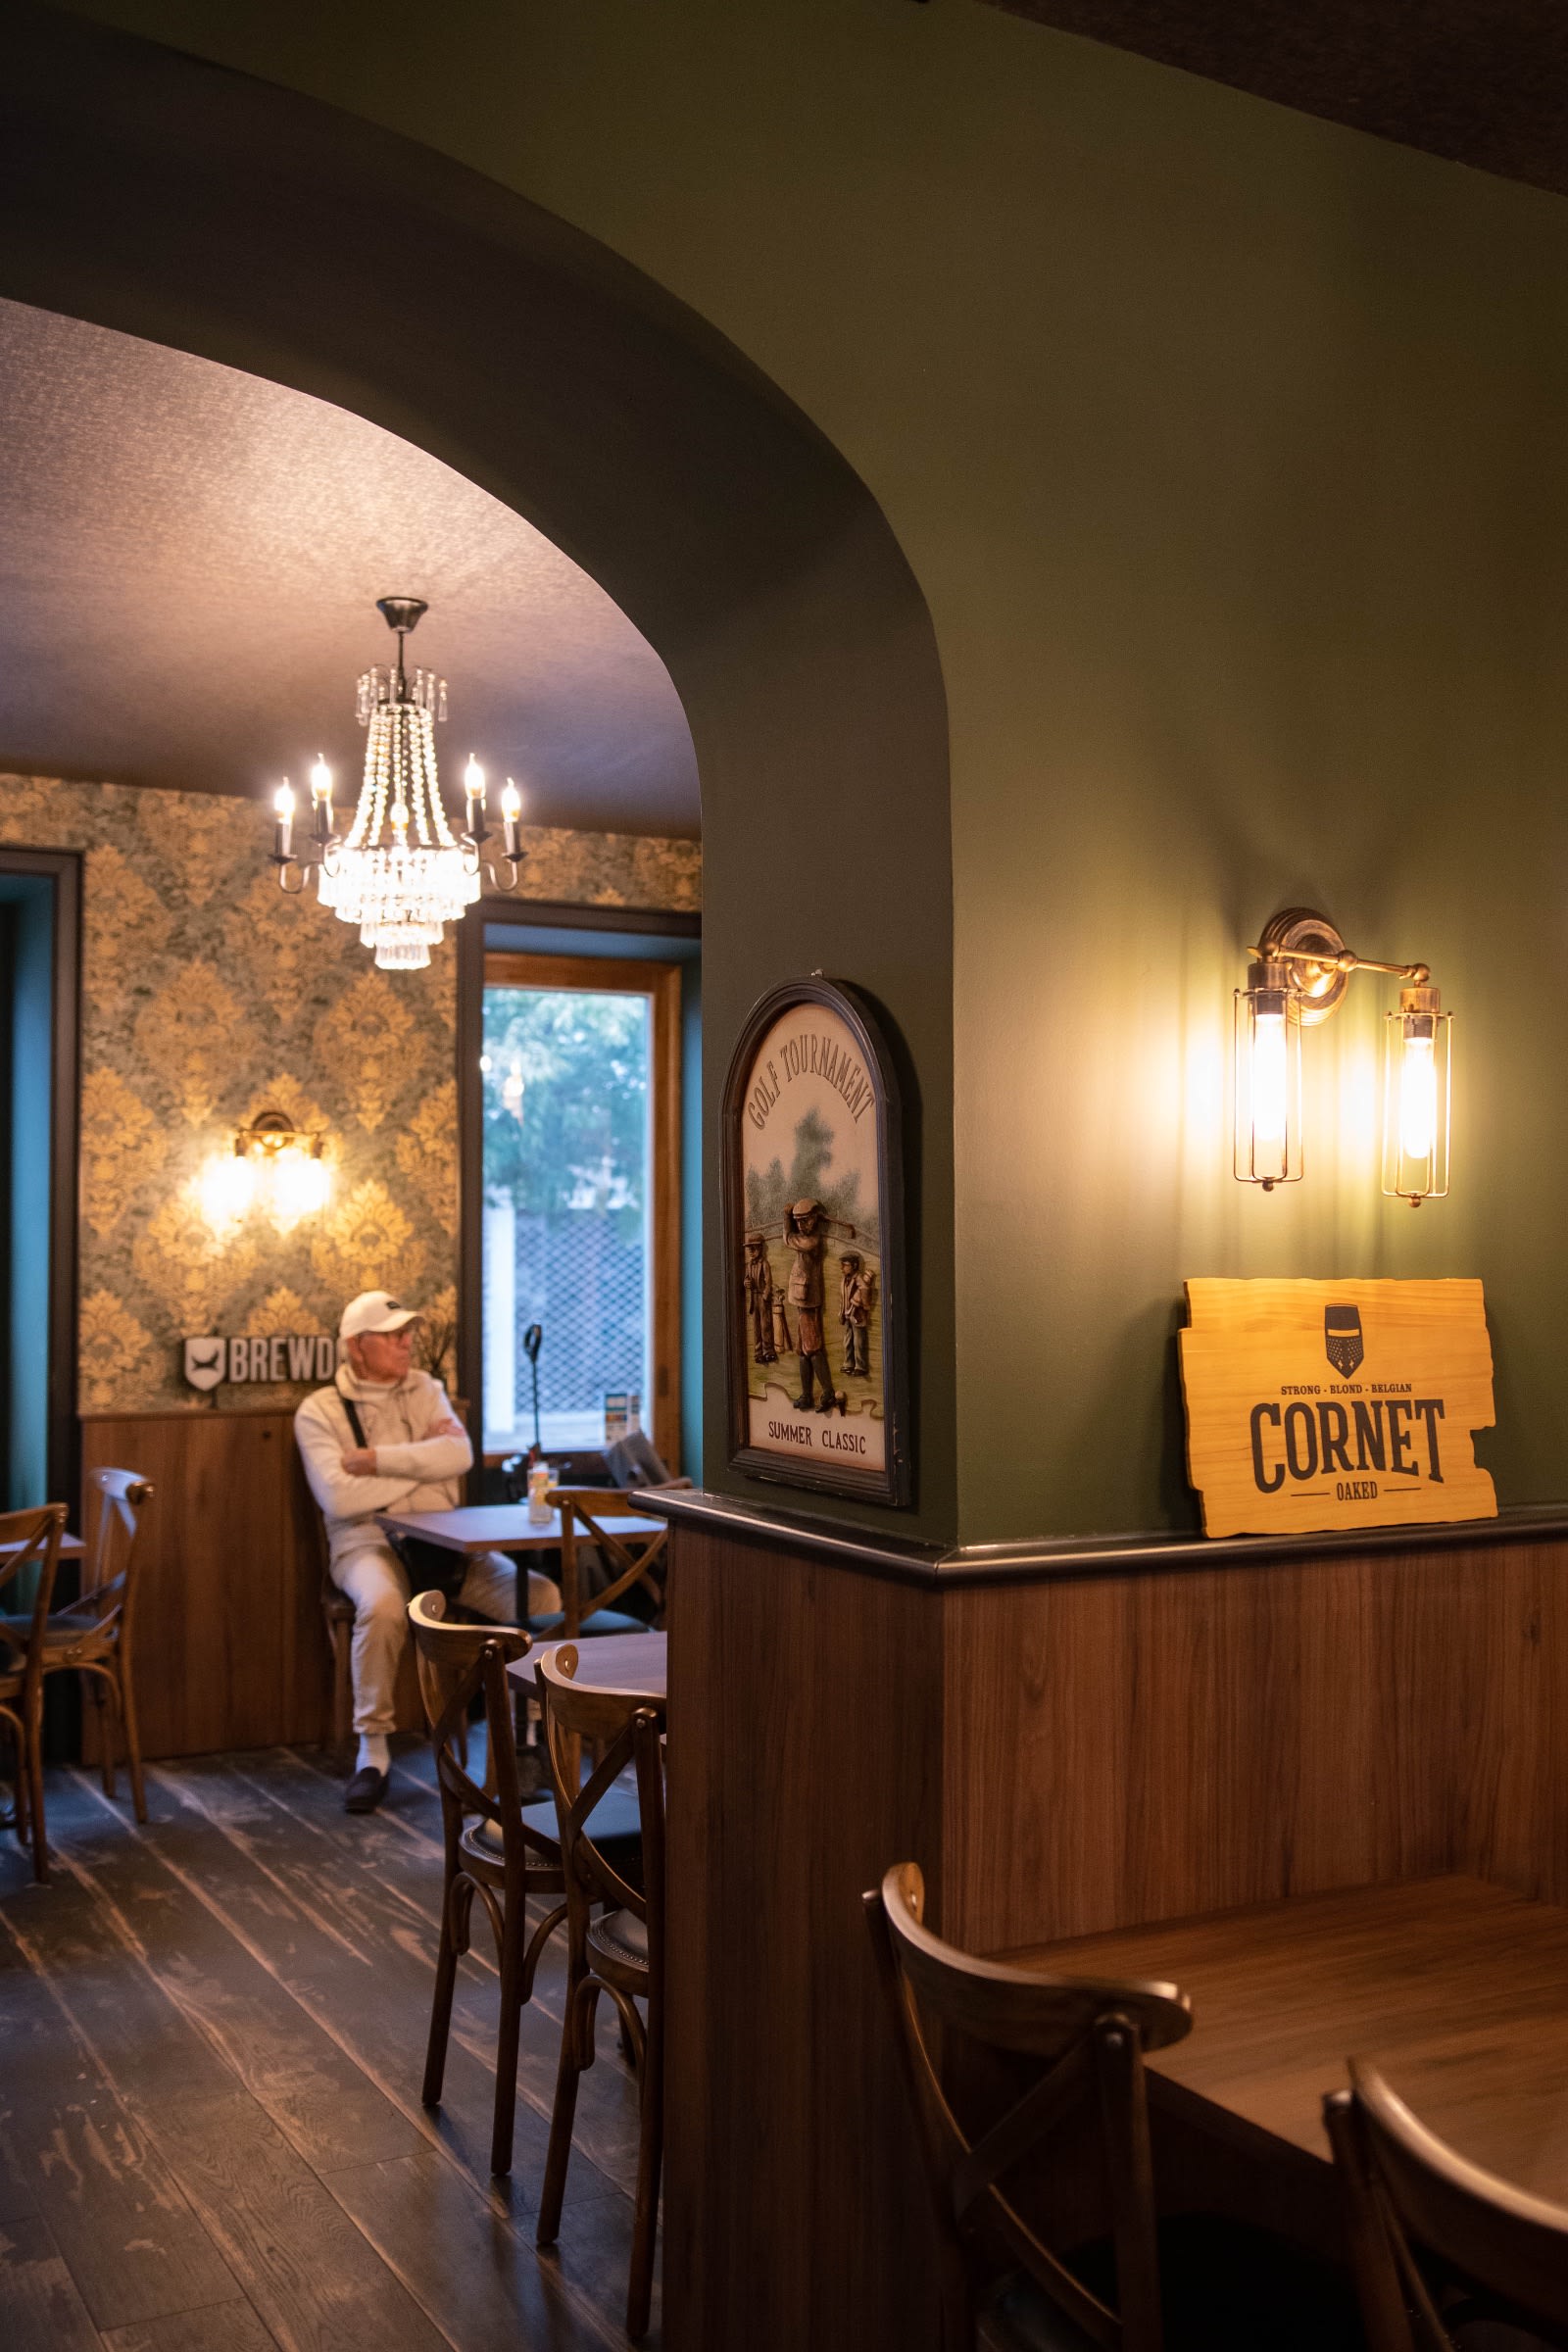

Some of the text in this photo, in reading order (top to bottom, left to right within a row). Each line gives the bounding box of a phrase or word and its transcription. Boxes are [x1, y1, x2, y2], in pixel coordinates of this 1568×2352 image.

[748, 1033, 875, 1130] GOLF TOURNAMENT
[1281, 1383, 1412, 1396] STRONG BLOND BELGIAN
[768, 1421, 866, 1454] SUMMER CLASSIC
[1250, 1398, 1446, 1494] CORNET
[1337, 1481, 1378, 1501] OAKED
